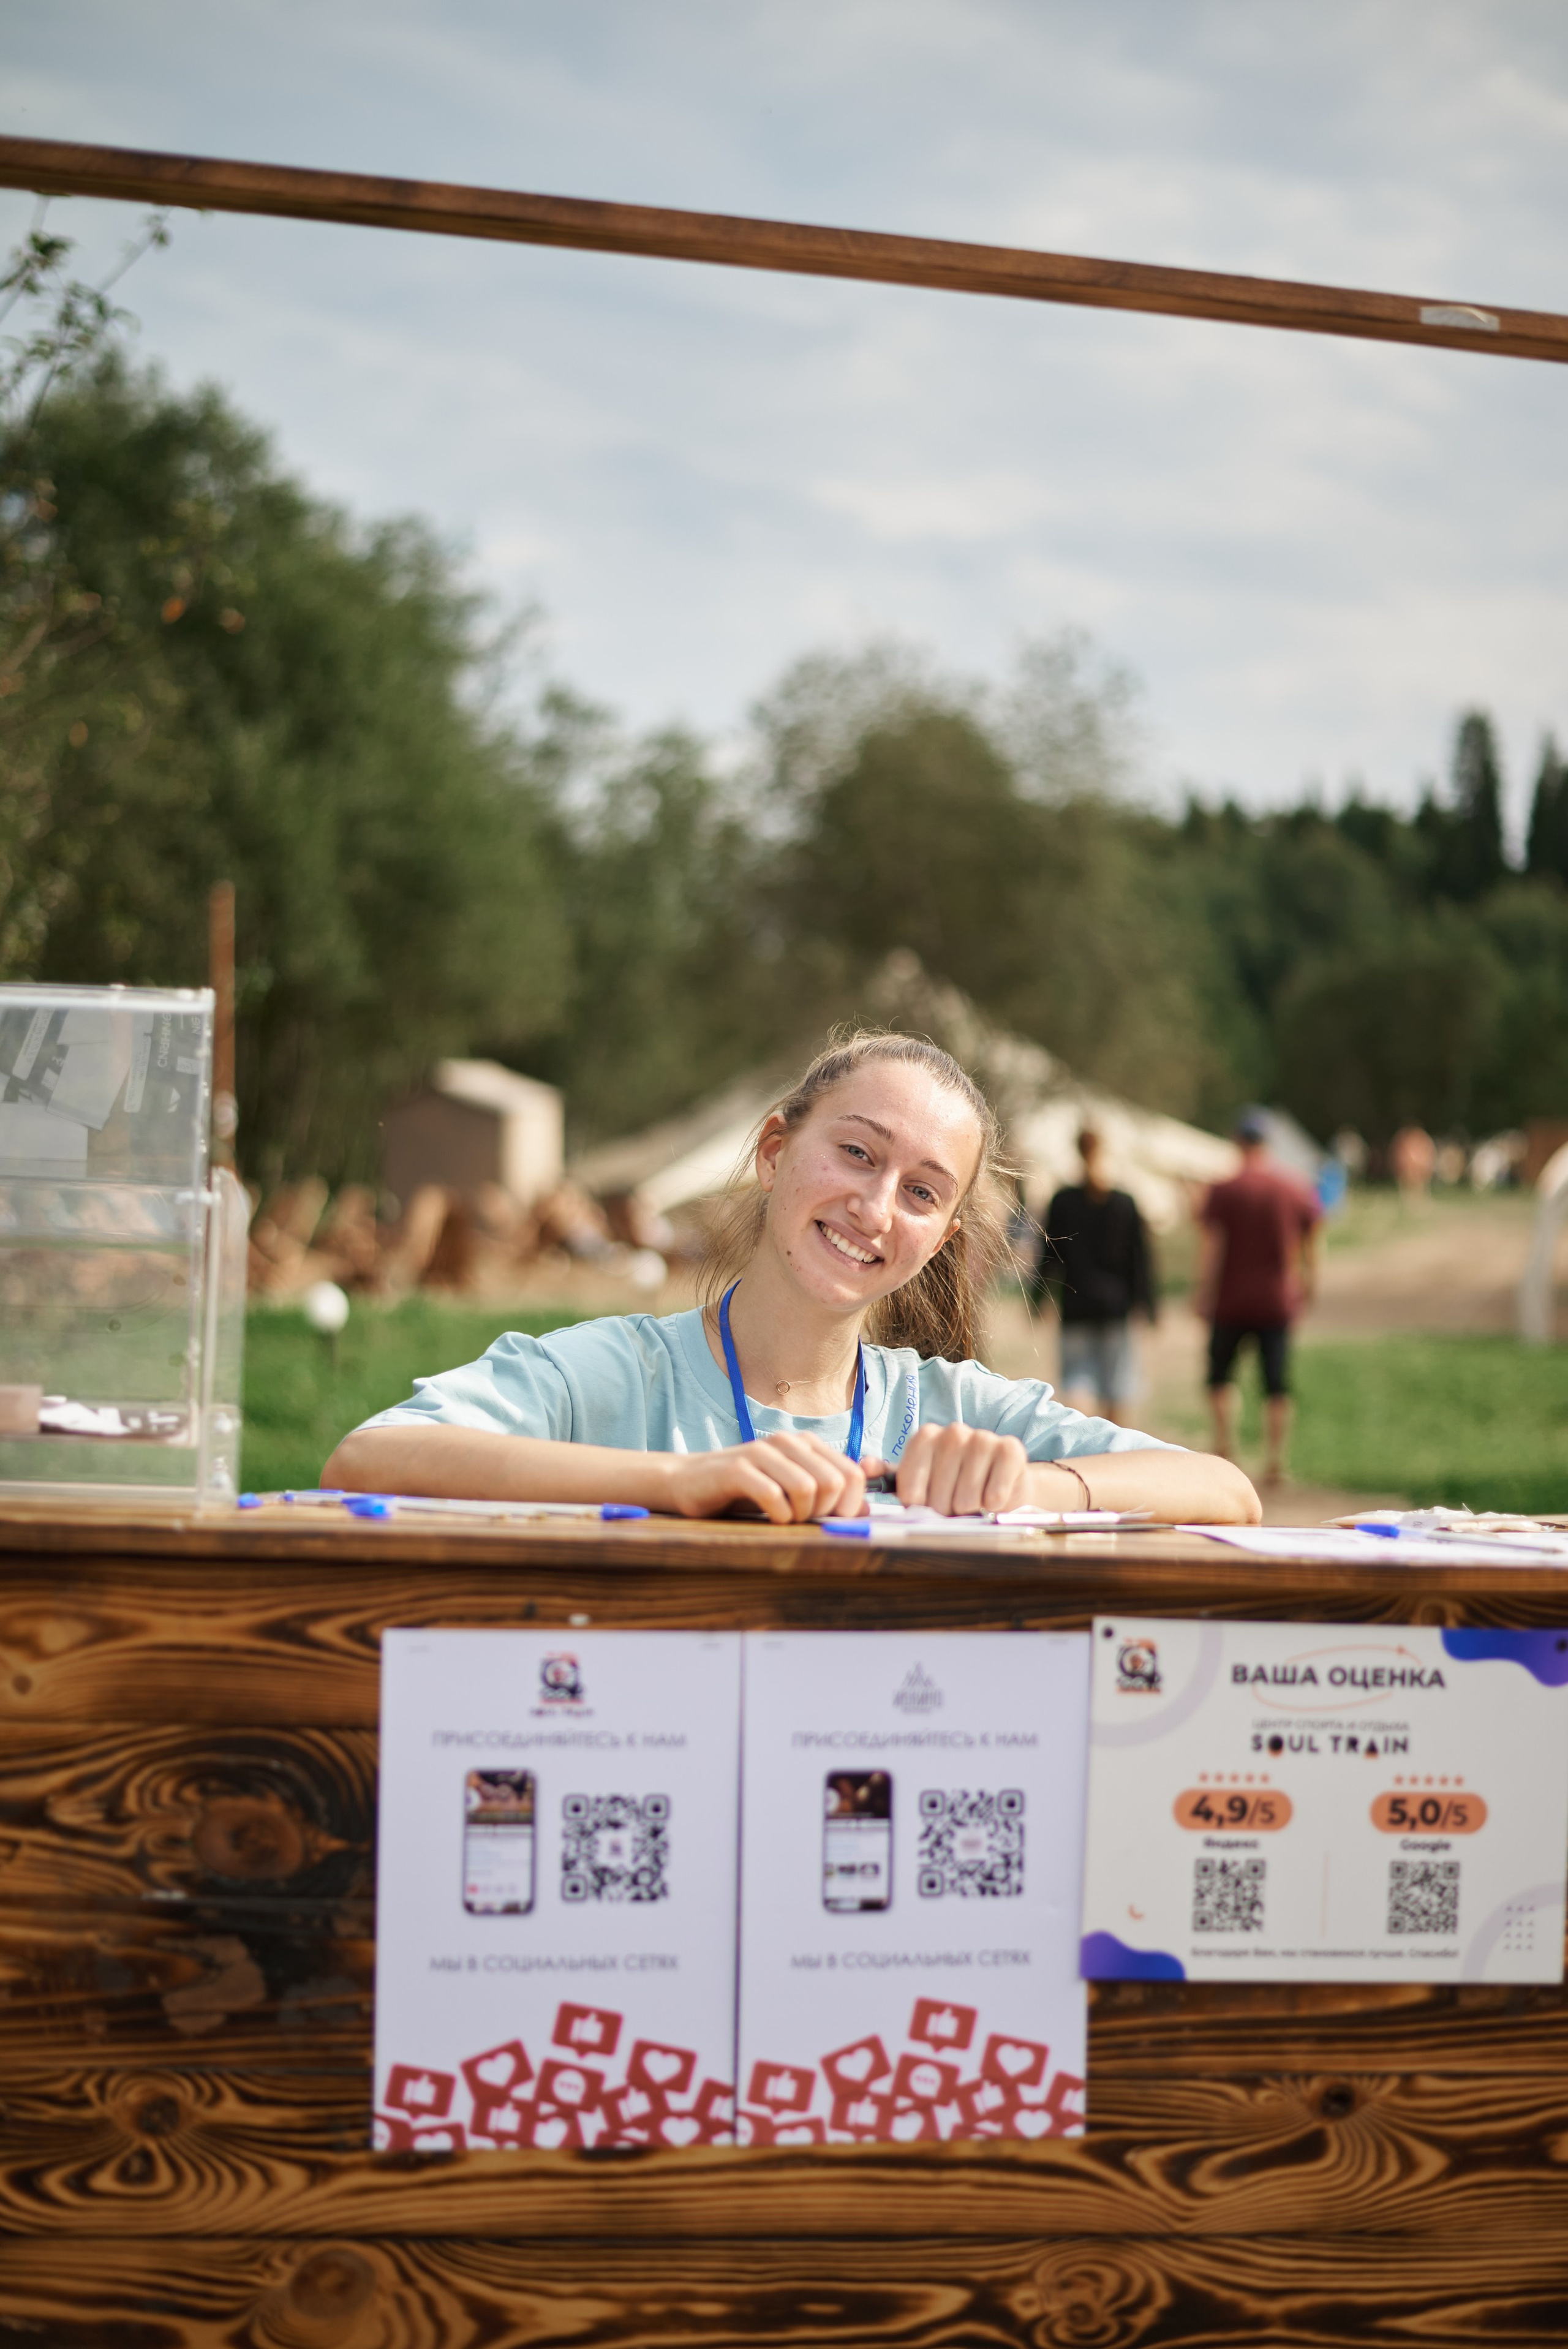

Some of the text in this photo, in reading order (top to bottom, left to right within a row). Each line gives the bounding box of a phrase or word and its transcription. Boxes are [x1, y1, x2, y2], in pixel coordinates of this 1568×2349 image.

[1232, 1664, 1446, 1689] ВАША ОЦЕНКА
[432, 1727, 687, 1749] ПРИСОЕДИНЯЙТЕСЬ К НАМ
[791, 1727, 1039, 1749] ПРИСОЕДИНЯЙТЕСЬ К НАМ
[1251, 1734, 1409, 1757] SOUL TRAIN
[1190, 1794, 1276, 1828] 4,9/5
[1388, 1797, 1468, 1830] 5,0/5
[1400, 1838, 1452, 1853] Google
[429, 1952, 679, 1972] МЫ В СОЦИАЛЬНЫХ СЕТЯХ
[791, 1949, 1031, 1970] МЫ В СОЦИАЛЬНЫХ СЕТЯХ
